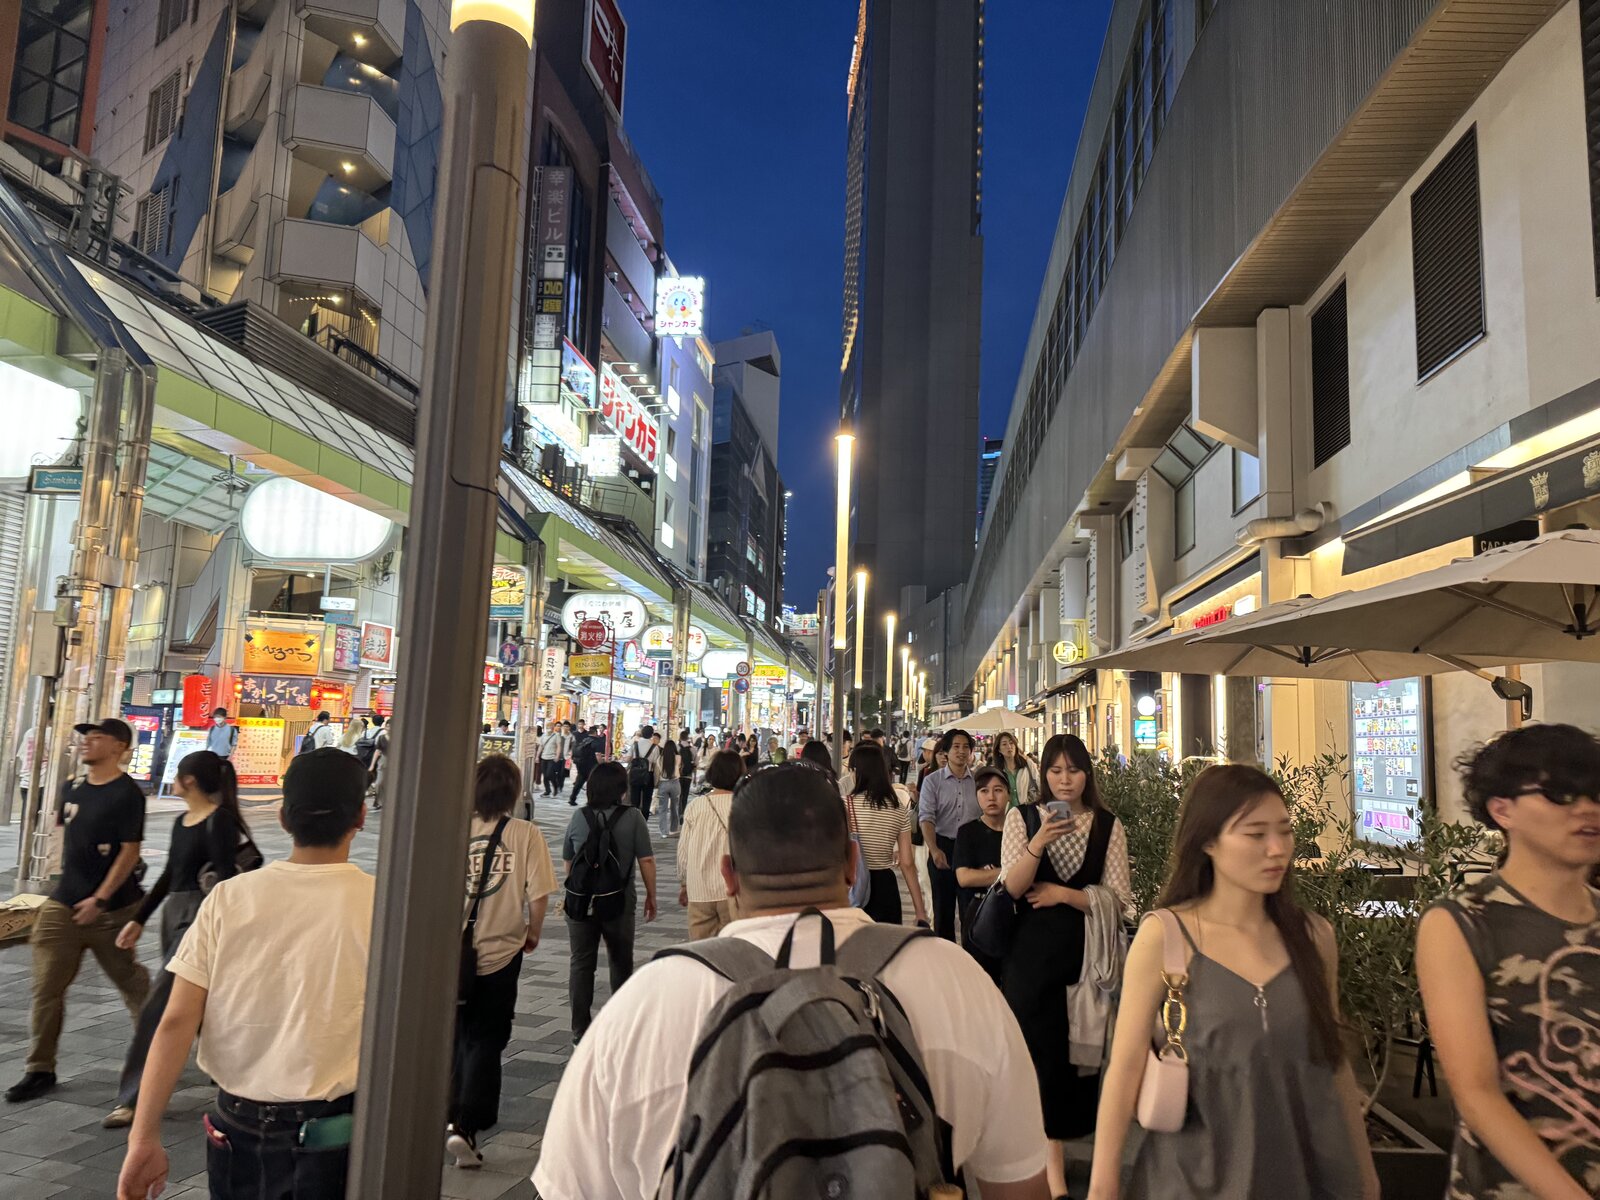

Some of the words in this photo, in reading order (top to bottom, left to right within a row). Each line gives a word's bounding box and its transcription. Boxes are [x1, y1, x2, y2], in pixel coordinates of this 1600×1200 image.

[545, 169, 565, 240] 幸楽ビル
[544, 281, 563, 295] DVD
[602, 374, 657, 462] ジャンカラ
[580, 631, 603, 641] 消火栓
[662, 661, 671, 674] P
[739, 665, 748, 673] 30
[483, 740, 514, 751] カラオ
